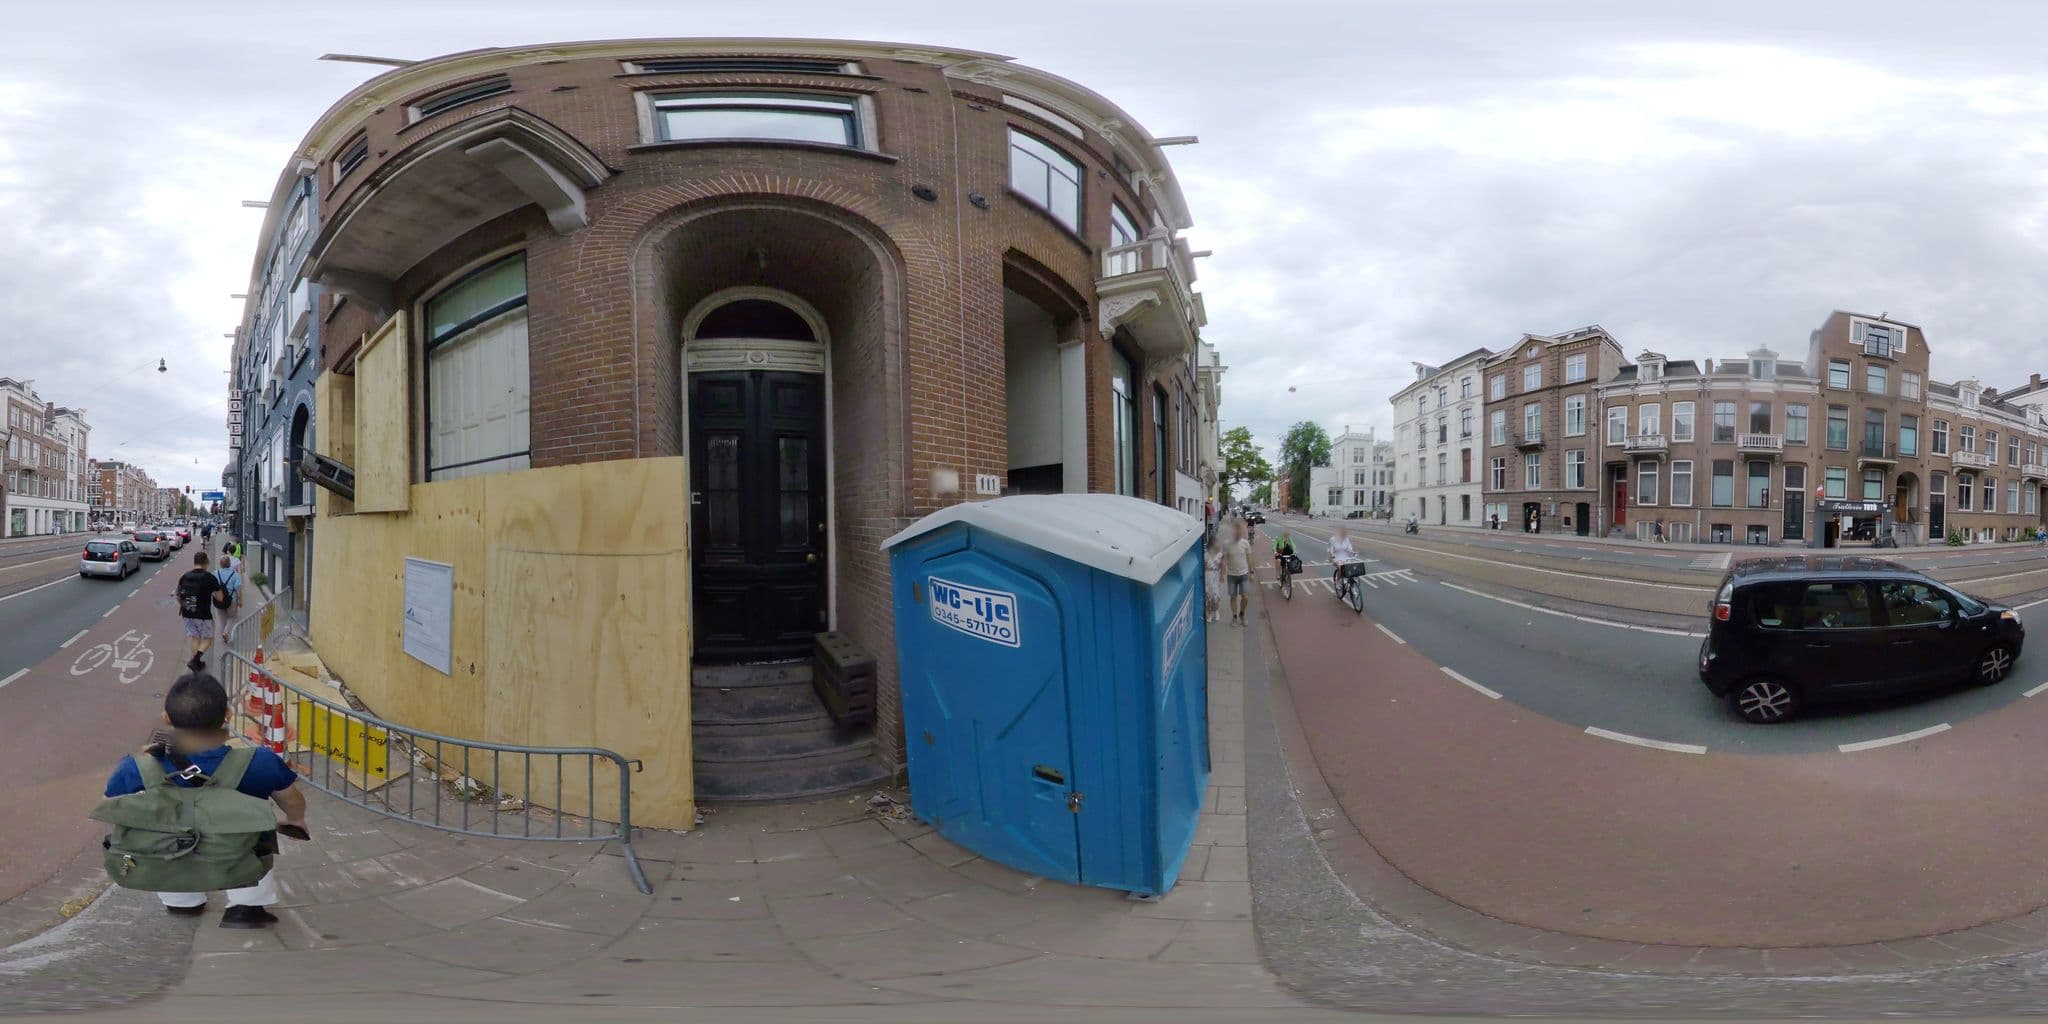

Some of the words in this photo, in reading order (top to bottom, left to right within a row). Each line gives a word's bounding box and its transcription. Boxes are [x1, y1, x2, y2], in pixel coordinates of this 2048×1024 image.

[230, 390, 241, 446] HOTEL
[980, 476, 996, 491] 111
[934, 606, 1011, 639] 0345-571170
